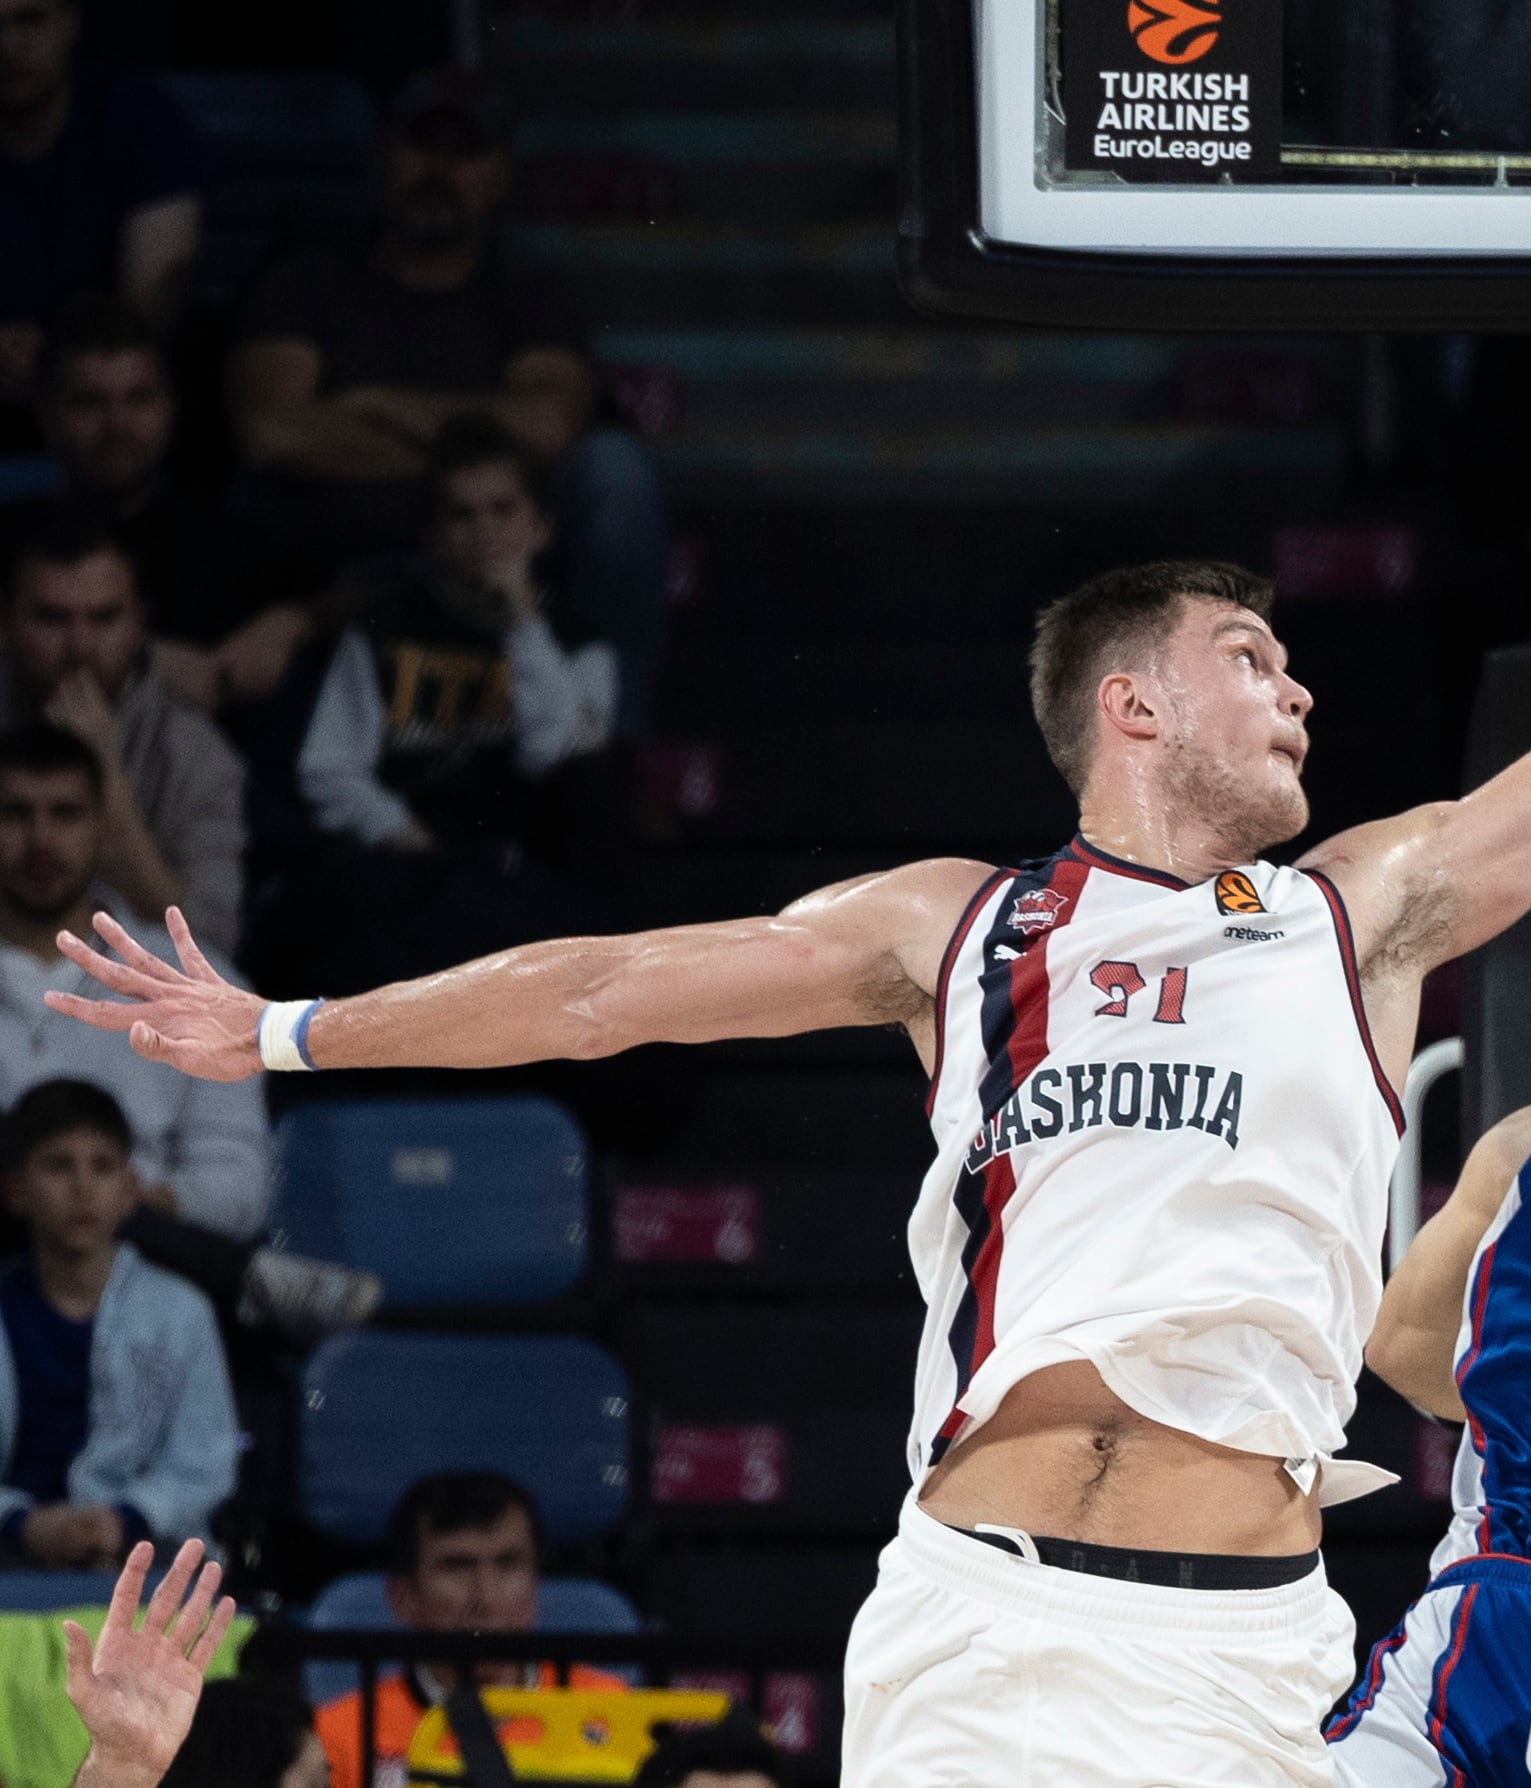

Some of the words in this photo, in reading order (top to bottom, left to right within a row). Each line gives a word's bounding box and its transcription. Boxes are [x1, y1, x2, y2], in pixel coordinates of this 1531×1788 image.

[1099, 72, 1249, 100] TURKISH
[1097, 103, 1251, 132] AIRLINES
[1093, 134, 1252, 166] EuroLeague
[1224, 926, 1285, 942] oneteam
